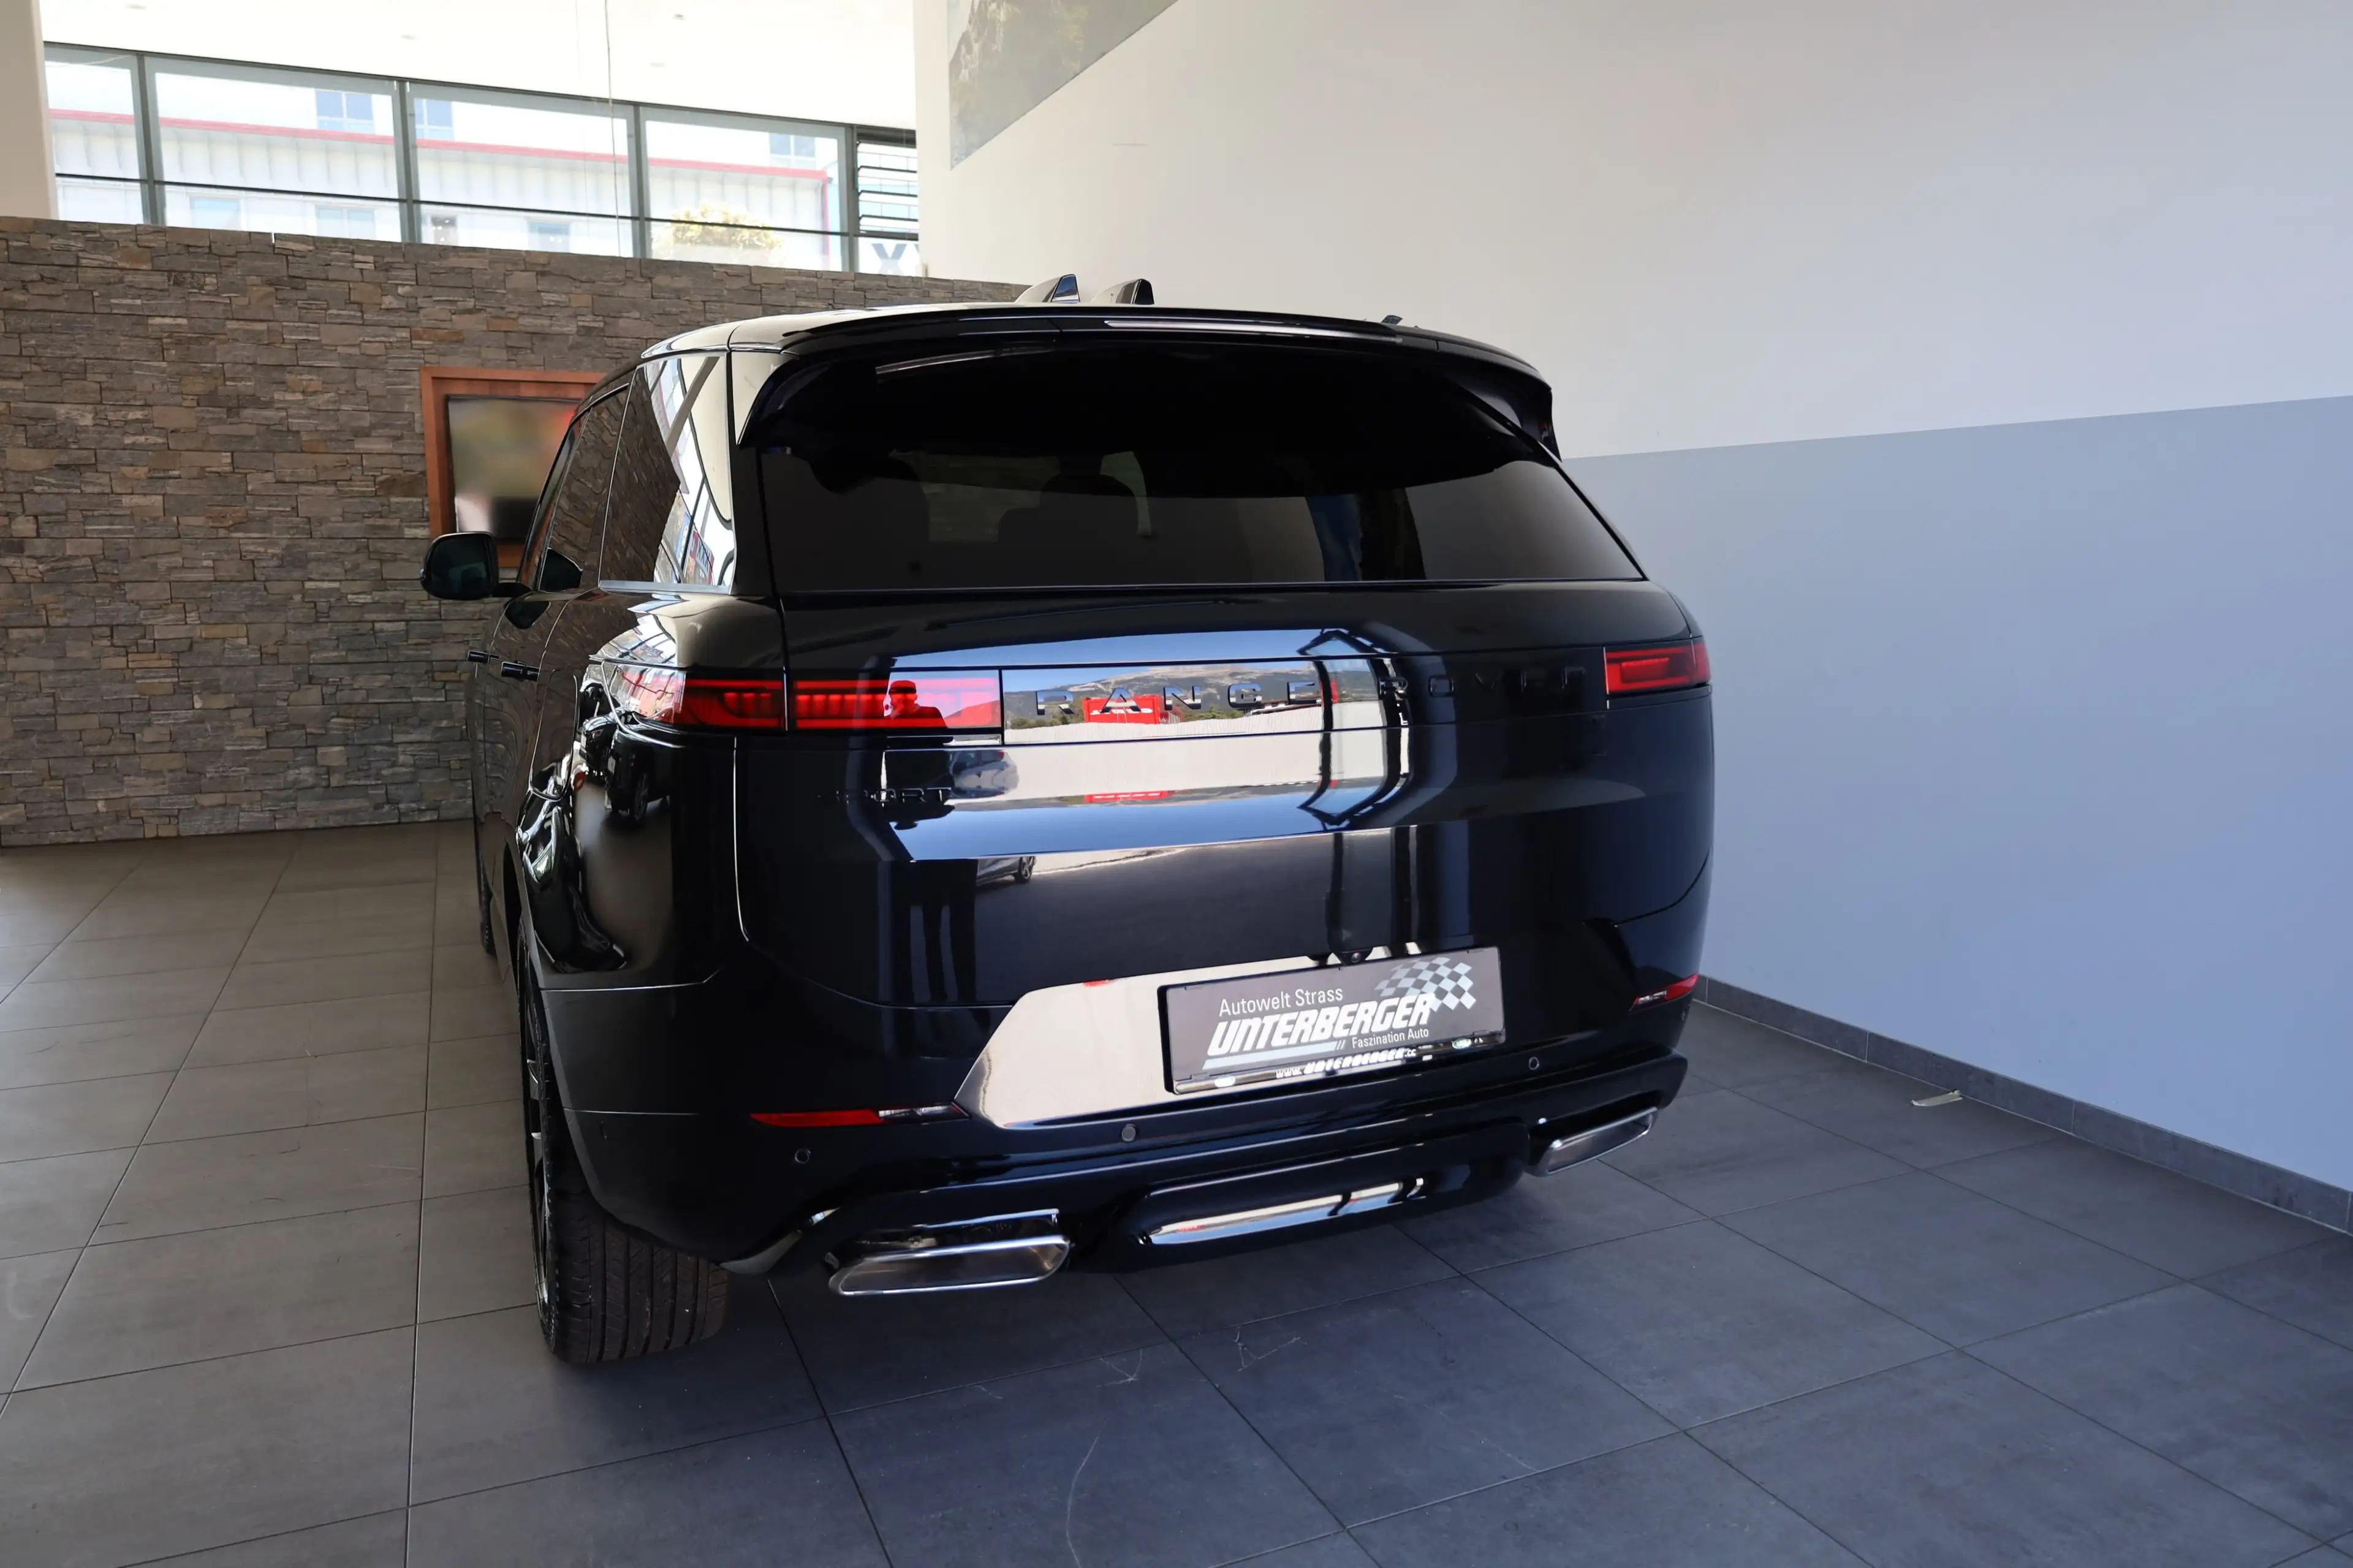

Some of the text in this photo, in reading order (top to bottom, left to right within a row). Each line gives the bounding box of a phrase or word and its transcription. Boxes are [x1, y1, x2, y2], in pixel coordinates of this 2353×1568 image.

[1036, 680, 1316, 716] RANGE
[1218, 988, 1344, 1017] Autowelt Strass
[1207, 992, 1436, 1056] UNTERBERGER
[1351, 1027, 1430, 1049] Faszination Auto
